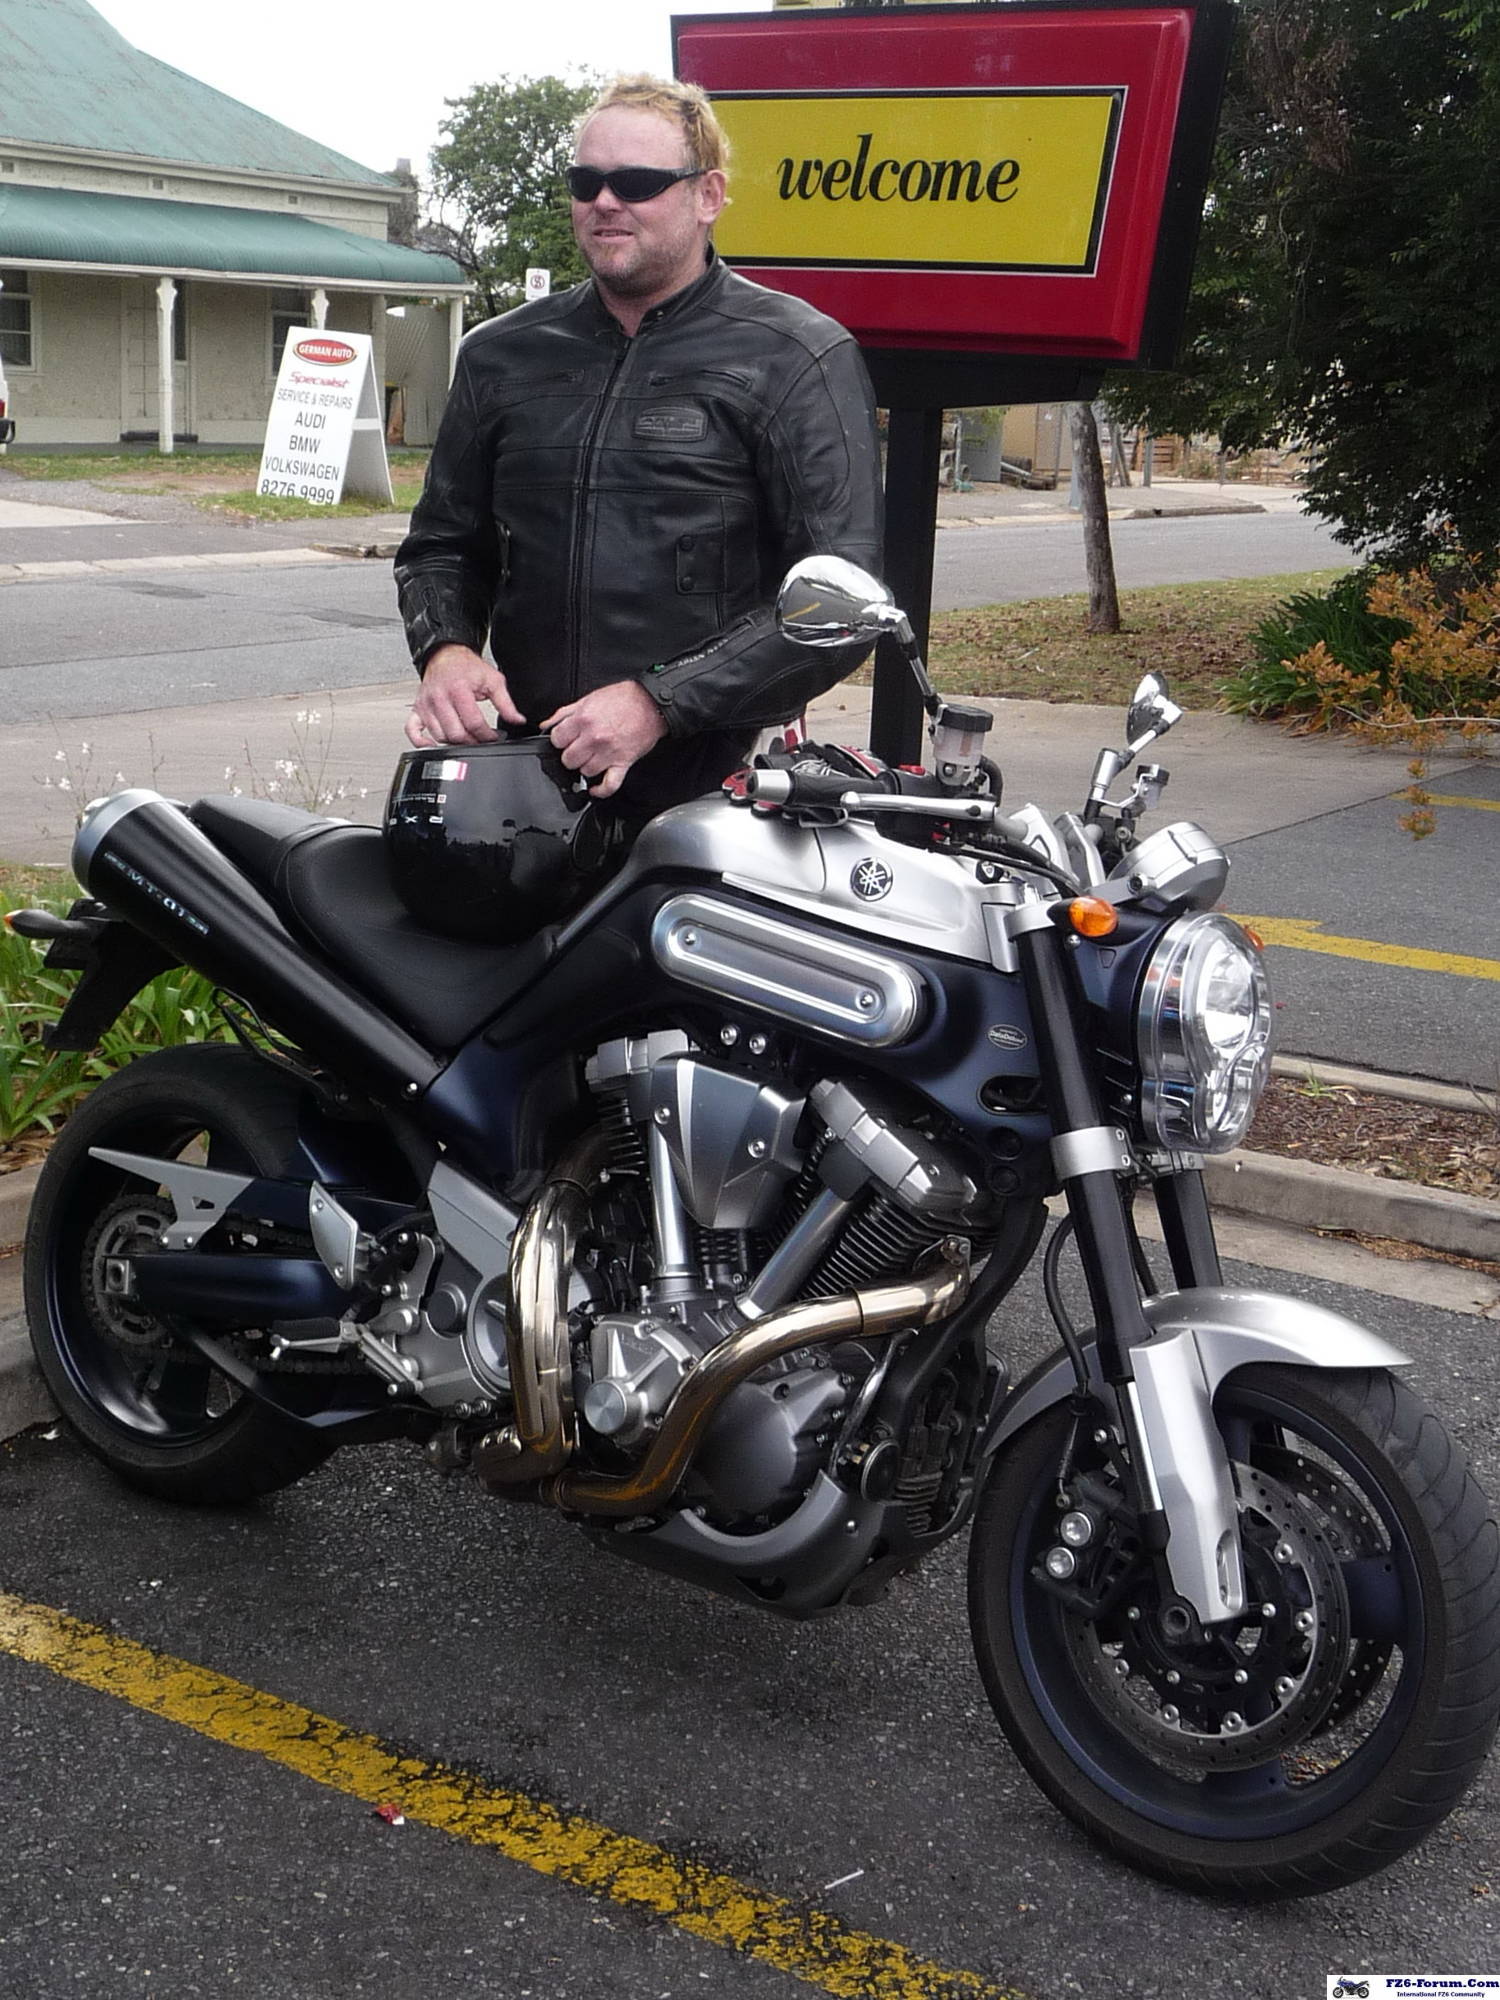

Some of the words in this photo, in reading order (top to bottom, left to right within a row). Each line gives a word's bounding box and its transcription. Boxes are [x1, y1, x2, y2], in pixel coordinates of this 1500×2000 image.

[777, 133, 1020, 203] welcome
[298, 344, 329, 356] GERMAN
[329, 347, 353, 359] AUTO
[288, 371, 349, 388] Specialist
[278, 388, 310, 404] SERVICE
[311, 393, 317, 405] &
[319, 393, 353, 410] REPAIRS
[294, 411, 327, 429] AUDI
[289, 434, 321, 453] BMW
[265, 456, 340, 480] VOLKSWAGEN
[261, 479, 296, 497] 8276
[300, 485, 335, 505] 9999
